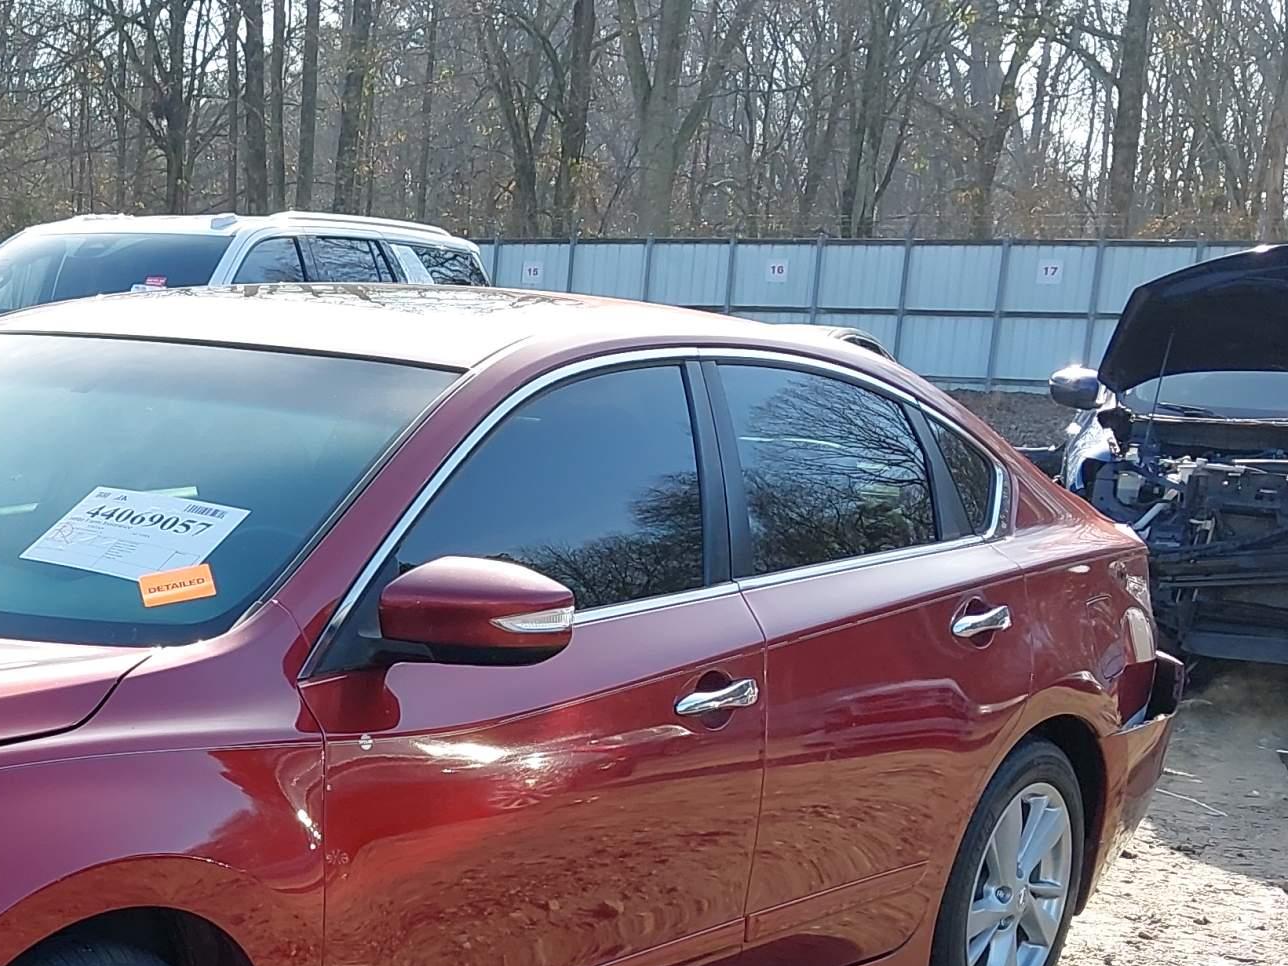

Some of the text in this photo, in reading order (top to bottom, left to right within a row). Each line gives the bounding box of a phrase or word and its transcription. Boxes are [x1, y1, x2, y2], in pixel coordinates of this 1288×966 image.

[527, 268, 538, 276] 15
[770, 265, 784, 275] 16
[1043, 267, 1058, 276] 17
[86, 504, 214, 537] 44069057
[147, 577, 206, 594] DETAILED
